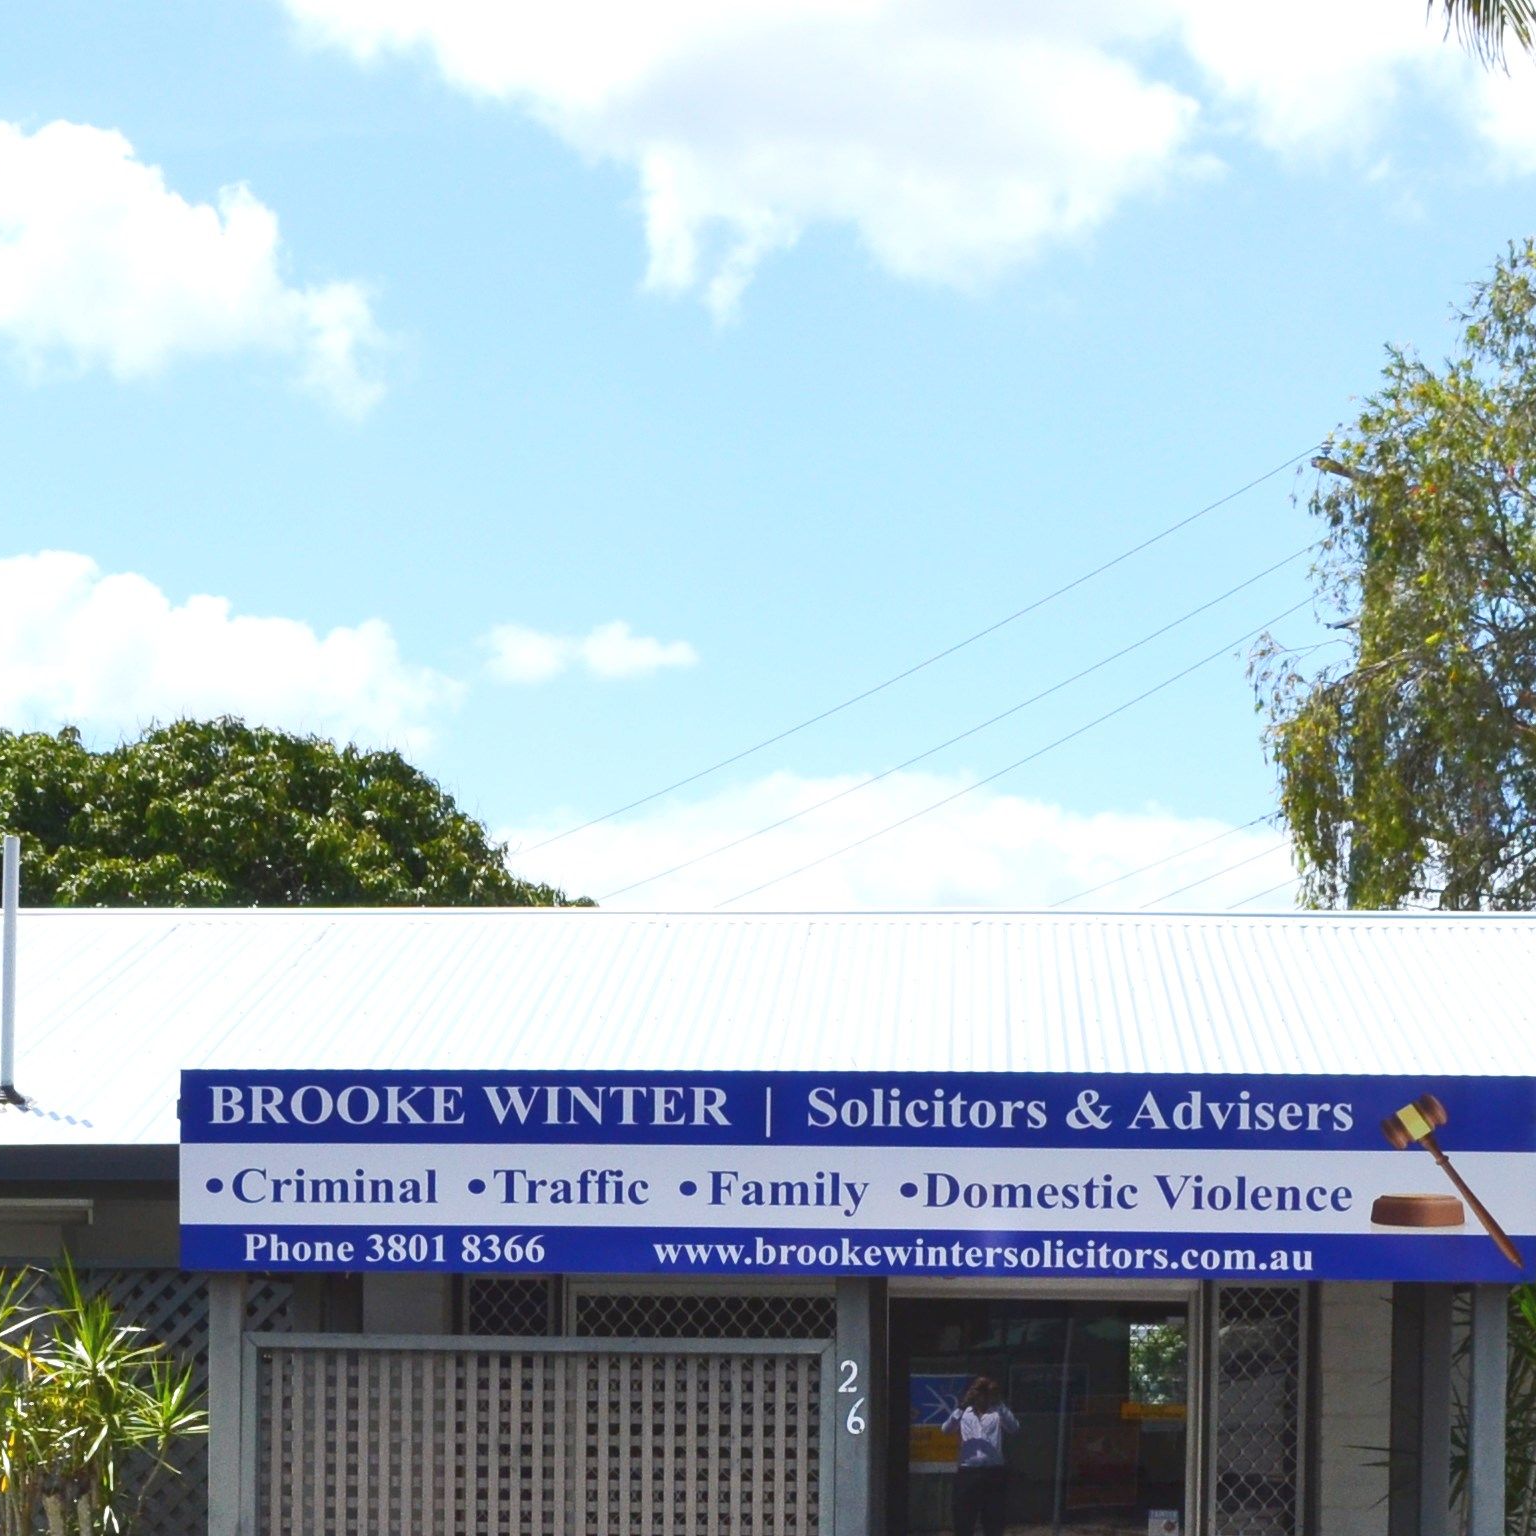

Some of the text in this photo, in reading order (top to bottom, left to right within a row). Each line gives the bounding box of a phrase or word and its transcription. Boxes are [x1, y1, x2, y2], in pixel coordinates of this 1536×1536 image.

[209, 1085, 1355, 1132] BROOKE WINTER Solicitors & Advisers
[230, 1167, 1354, 1218] Criminal Traffic Family Domestic Violence
[246, 1234, 544, 1262] Phone 3801 8366
[654, 1235, 1314, 1272] www.brookewintersolicitors.com.au
